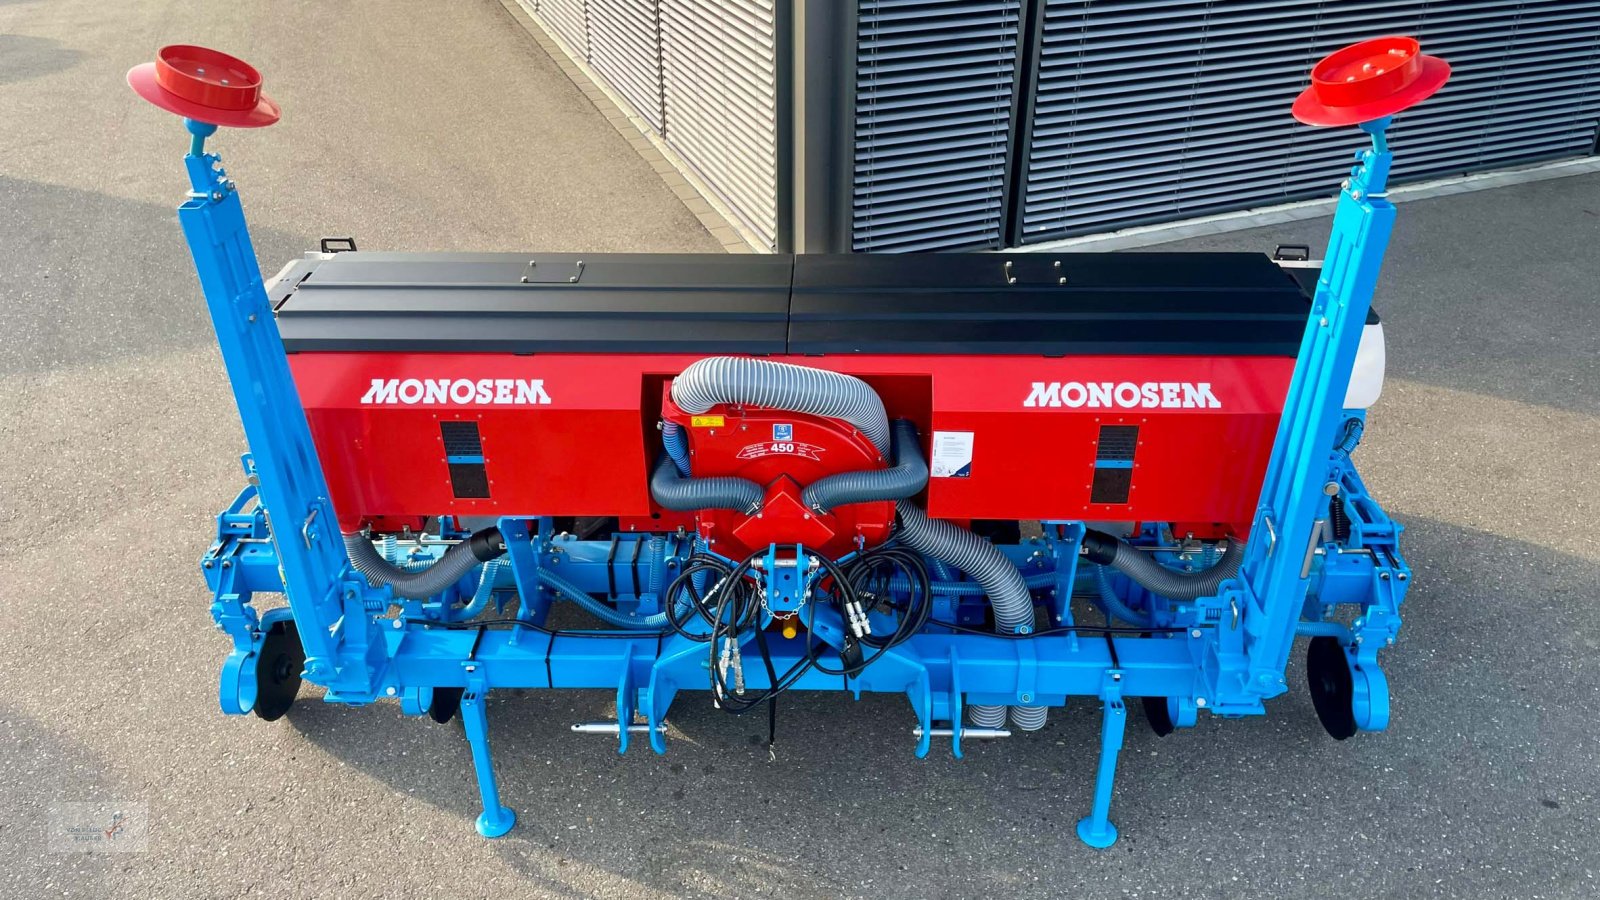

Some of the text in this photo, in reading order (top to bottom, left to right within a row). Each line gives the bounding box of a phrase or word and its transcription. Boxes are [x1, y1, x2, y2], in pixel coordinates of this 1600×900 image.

[361, 379, 551, 405] MONOSEM
[1023, 382, 1221, 409] MONOSEM
[770, 443, 794, 453] 450
